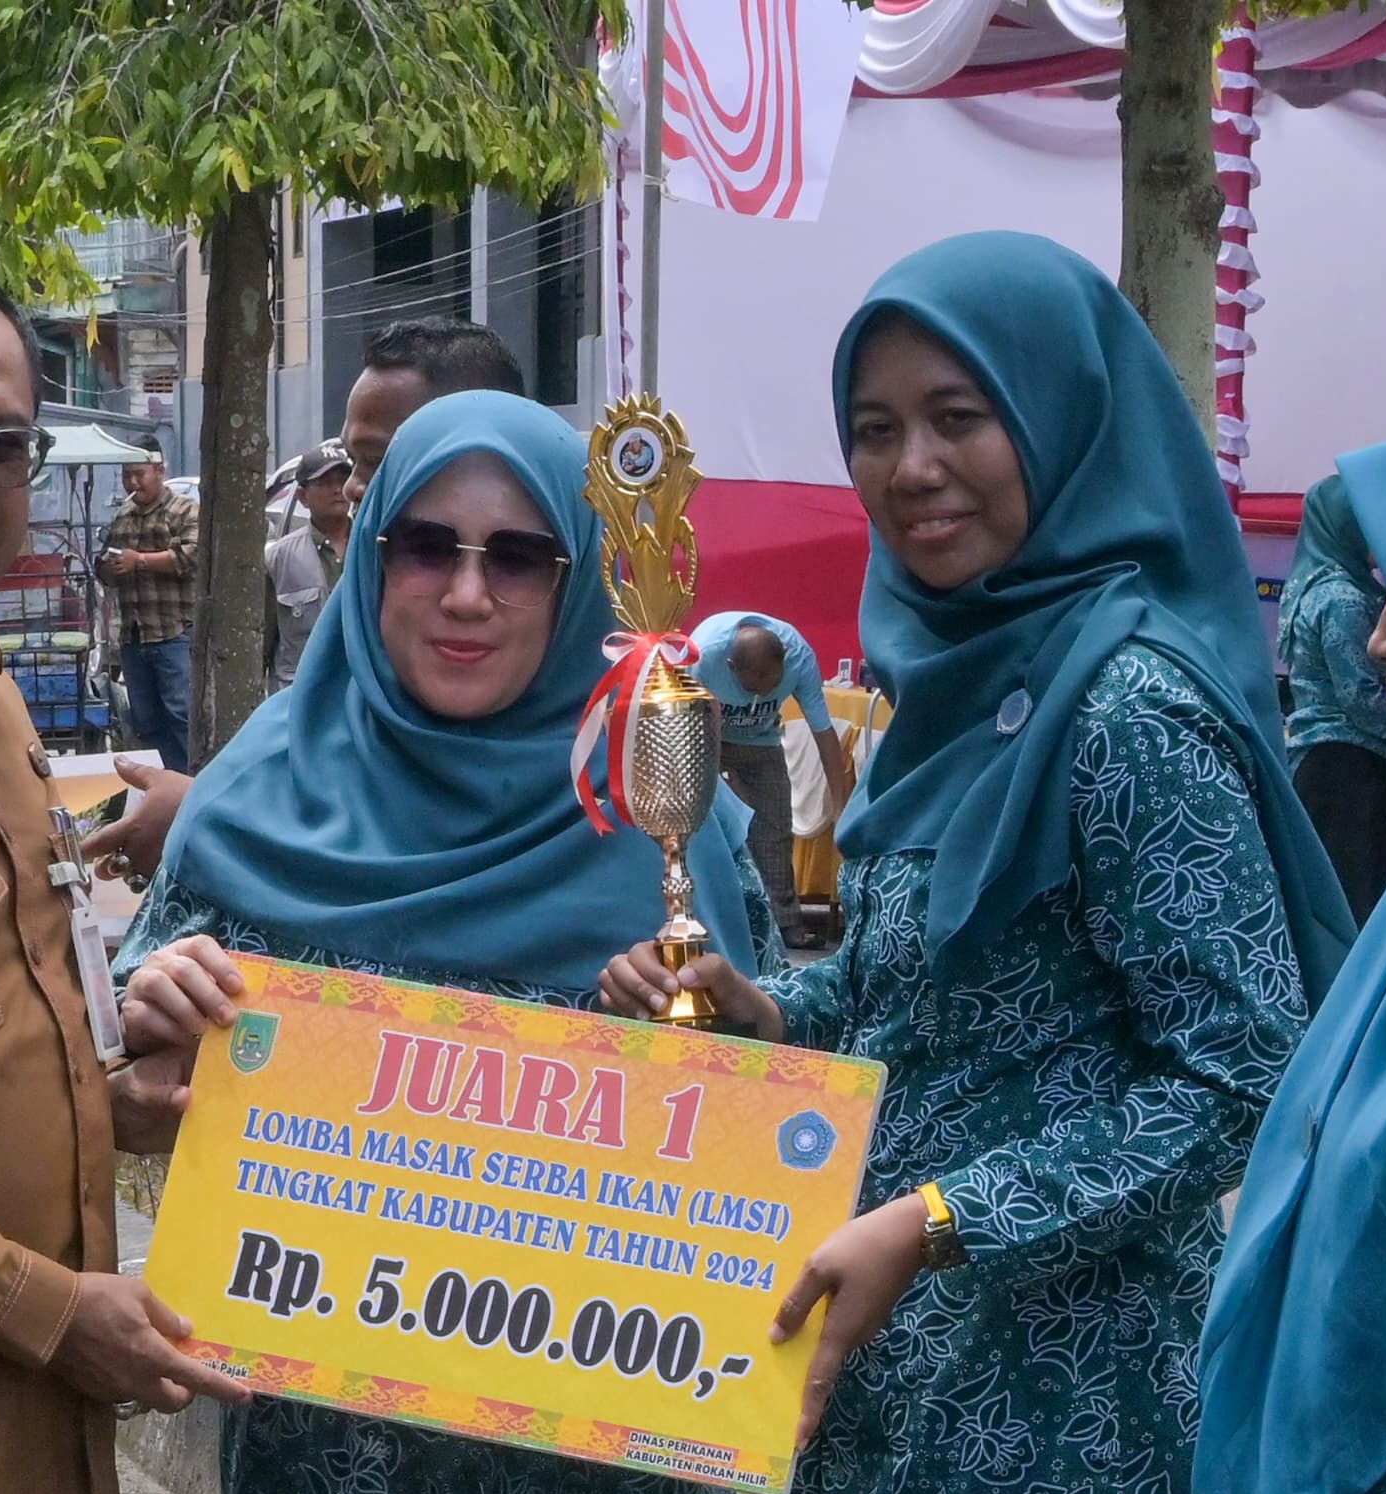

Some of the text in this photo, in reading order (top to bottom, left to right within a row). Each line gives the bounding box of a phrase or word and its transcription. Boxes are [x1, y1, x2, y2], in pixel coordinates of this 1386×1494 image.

[357, 1030, 704, 1160] JUARA 1
[236, 1159, 776, 1291] TINGKAT KABUPATEN TAHUN 2024
[243, 1107, 791, 1242] LOMBA MASAK SERBA IKAN (LMSI)
[219, 1362, 248, 1378] Pajak
[227, 1230, 751, 1399] Rp. 5.000.000,-
[625, 1449, 767, 1487] KABUPATEN ROKAN HILIR
[629, 1432, 732, 1461] DINAS PERIKANAN
